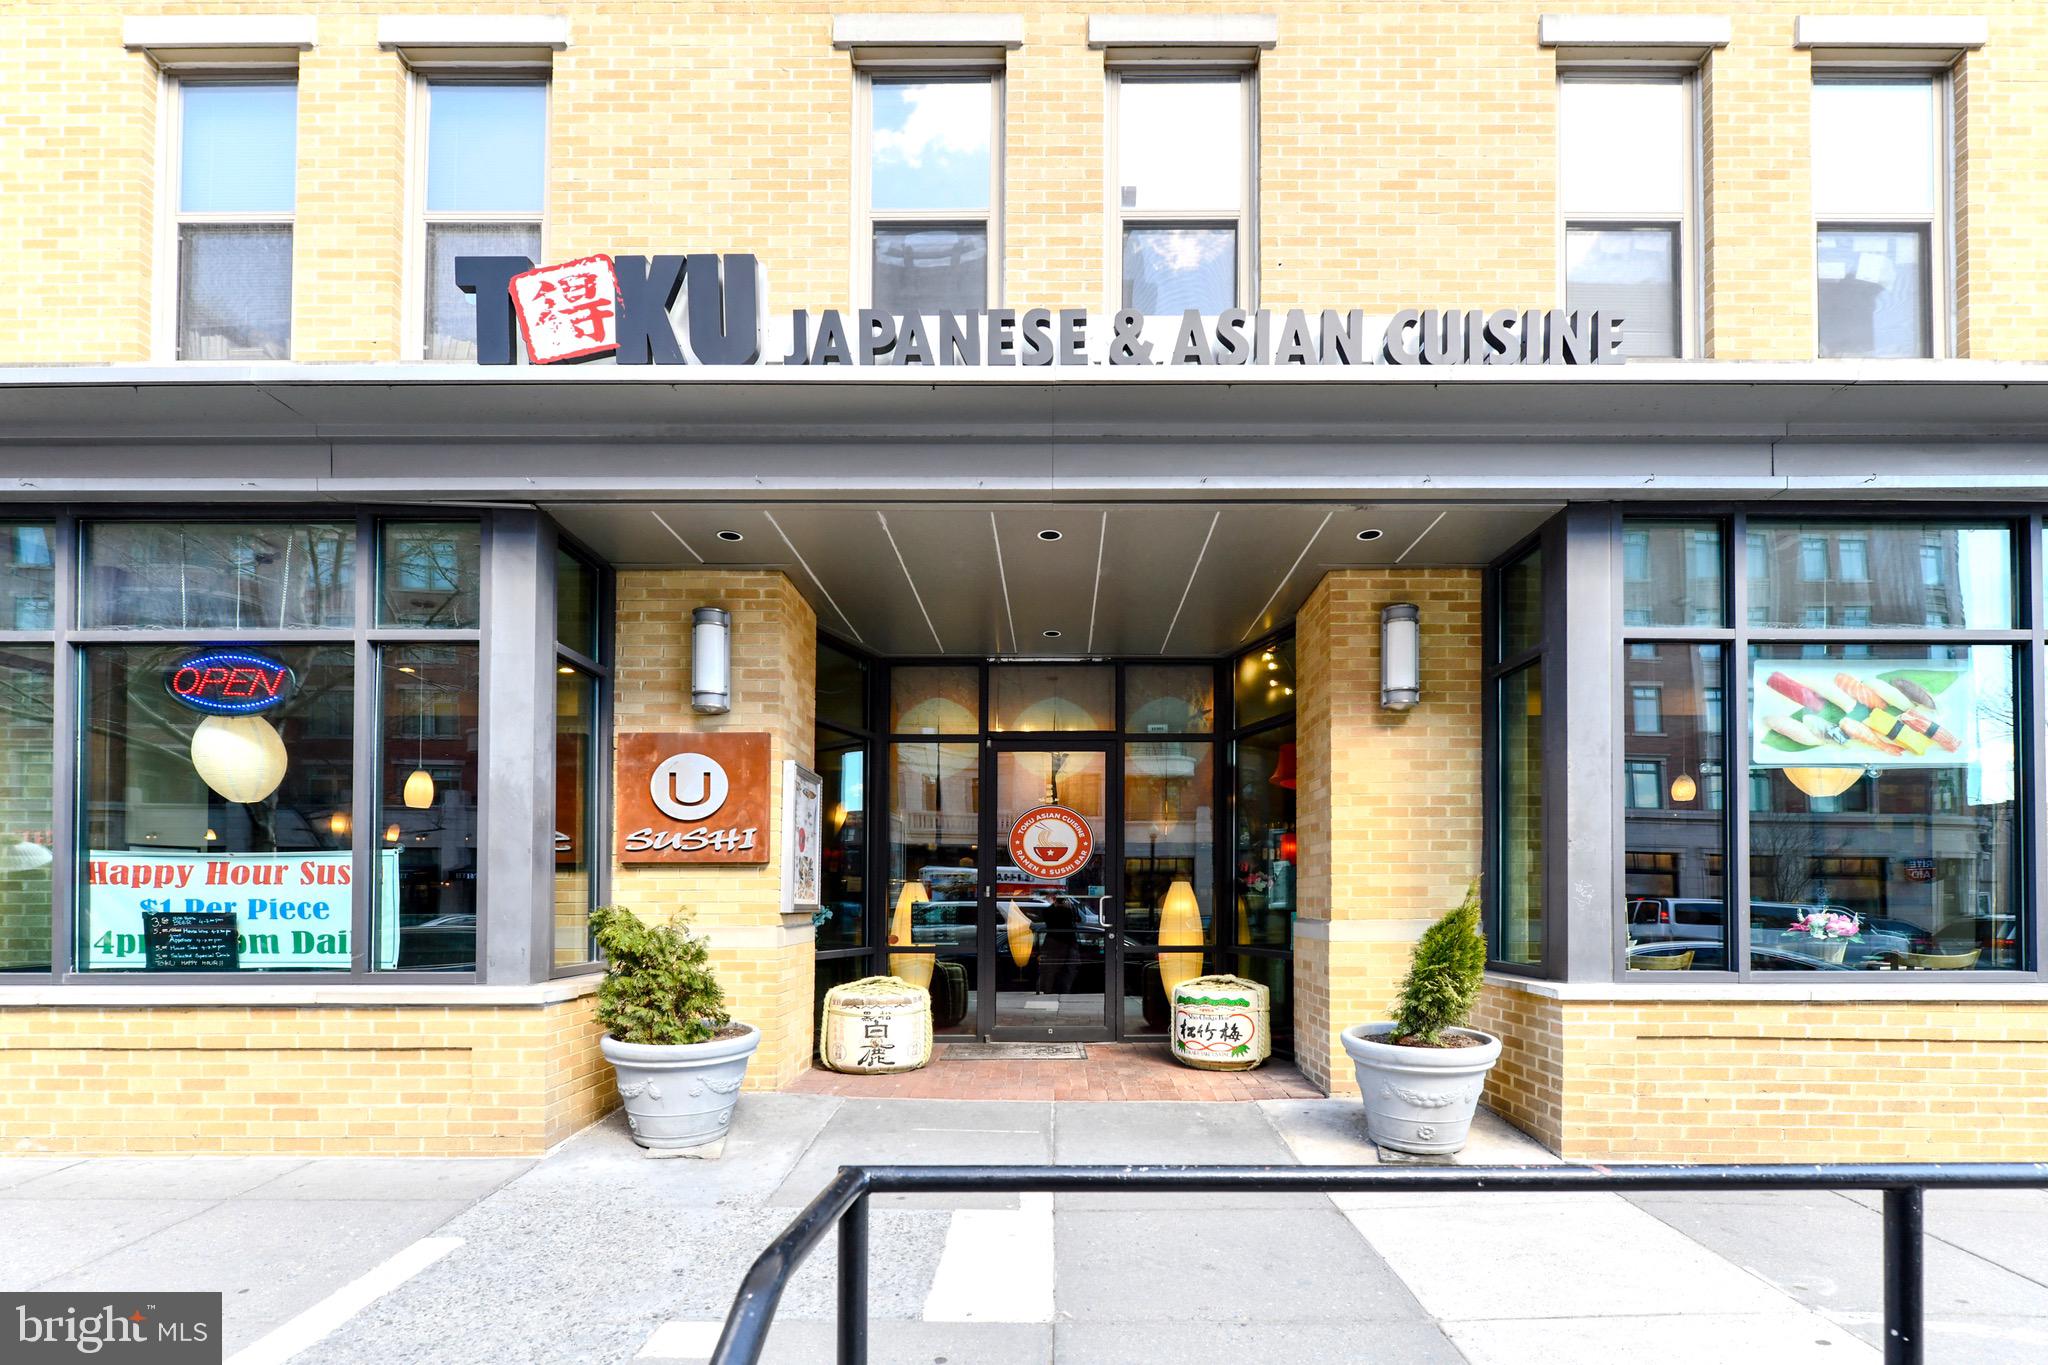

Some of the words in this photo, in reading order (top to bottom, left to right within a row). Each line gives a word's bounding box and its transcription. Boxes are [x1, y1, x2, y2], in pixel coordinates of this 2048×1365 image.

[784, 308, 1089, 366] JAPANESE
[1109, 309, 1154, 366] &
[1172, 309, 1363, 366] ASIAN
[1384, 309, 1625, 366] CUISINE
[173, 667, 286, 696] OPEN
[669, 772, 711, 806] U
[1018, 818, 1035, 834] TOKU
[1036, 812, 1061, 820] ASIAN
[1062, 815, 1085, 838] CUISINE
[625, 827, 758, 852] SUSHI
[89, 861, 195, 888] Happy
[204, 861, 289, 885] Hour
[300, 861, 351, 885] Sus
[1016, 849, 1039, 872] RAMEN
[1049, 864, 1075, 875] SUSHI
[1074, 850, 1087, 865] BAR
[185, 898, 238, 913] Per
[248, 898, 330, 920] Piece
[291, 930, 352, 954] Dai
